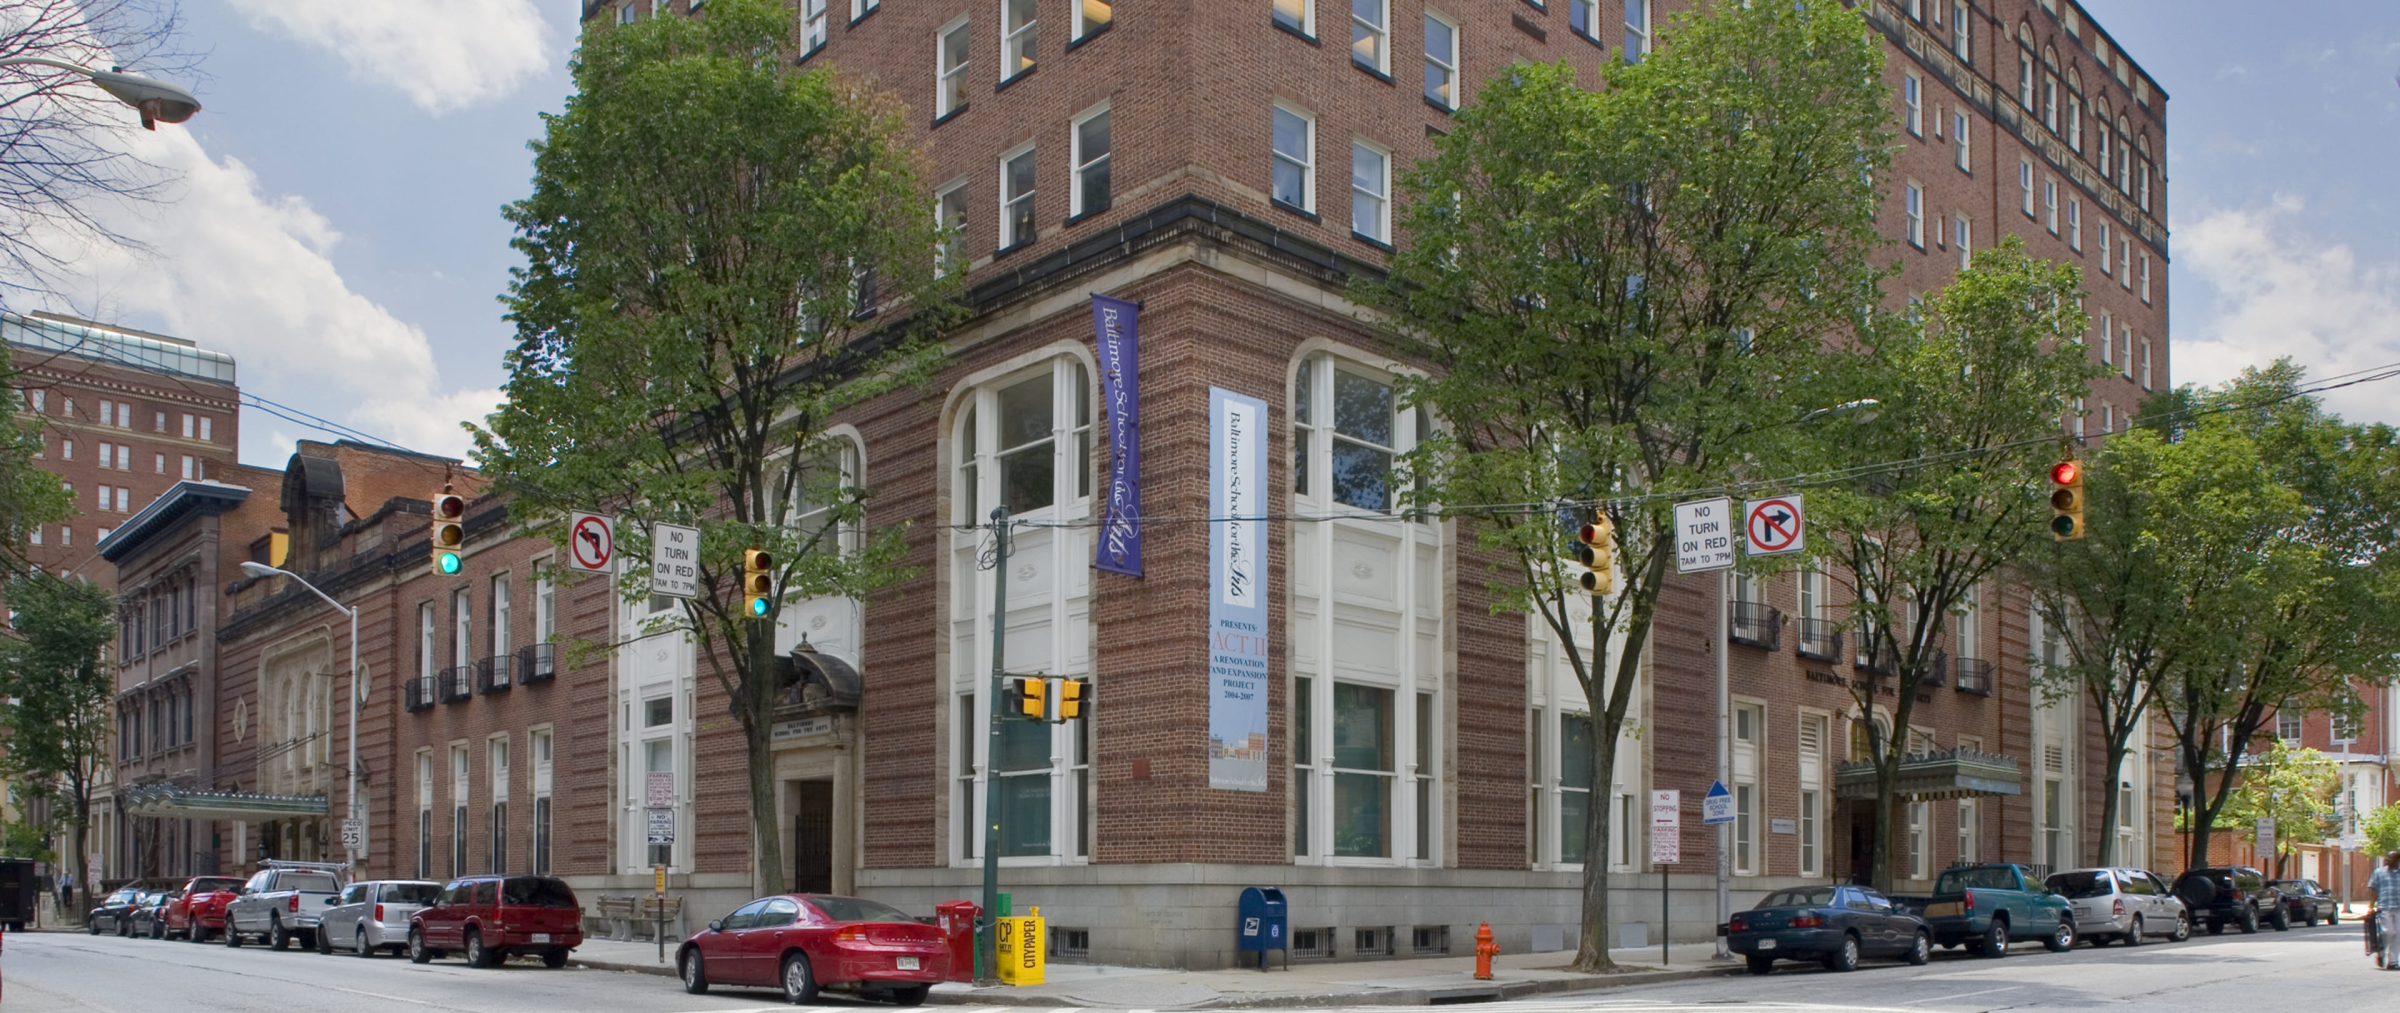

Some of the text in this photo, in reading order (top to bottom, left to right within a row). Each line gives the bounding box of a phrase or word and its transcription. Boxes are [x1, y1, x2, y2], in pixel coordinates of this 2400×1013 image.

[1103, 307, 1123, 389] Baltimore
[1115, 390, 1129, 450] School
[1230, 411, 1241, 475] Baltimore
[1230, 475, 1242, 520] School
[1695, 506, 1711, 518] NO
[1230, 521, 1242, 541] for
[1689, 521, 1719, 535] TURN
[670, 531, 684, 543] NO
[1682, 536, 1727, 553] ON RED
[664, 546, 688, 560] TURN
[1230, 542, 1241, 563] the
[1681, 551, 1731, 566] 7AM TO 7PM
[657, 563, 694, 578] ON RED
[654, 577, 695, 592] 7AM TO 7PM
[1220, 619, 1258, 632] PRESENTS:
[1211, 630, 1266, 656] ACT II
[1213, 655, 1265, 669] A RENOVATION
[1211, 666, 1268, 680] AND EXPANSION
[1223, 679, 1256, 690] PROJECT
[1224, 690, 1254, 701] 2004-2007
[343, 833, 358, 844] 25
[999, 922, 1012, 943] CP
